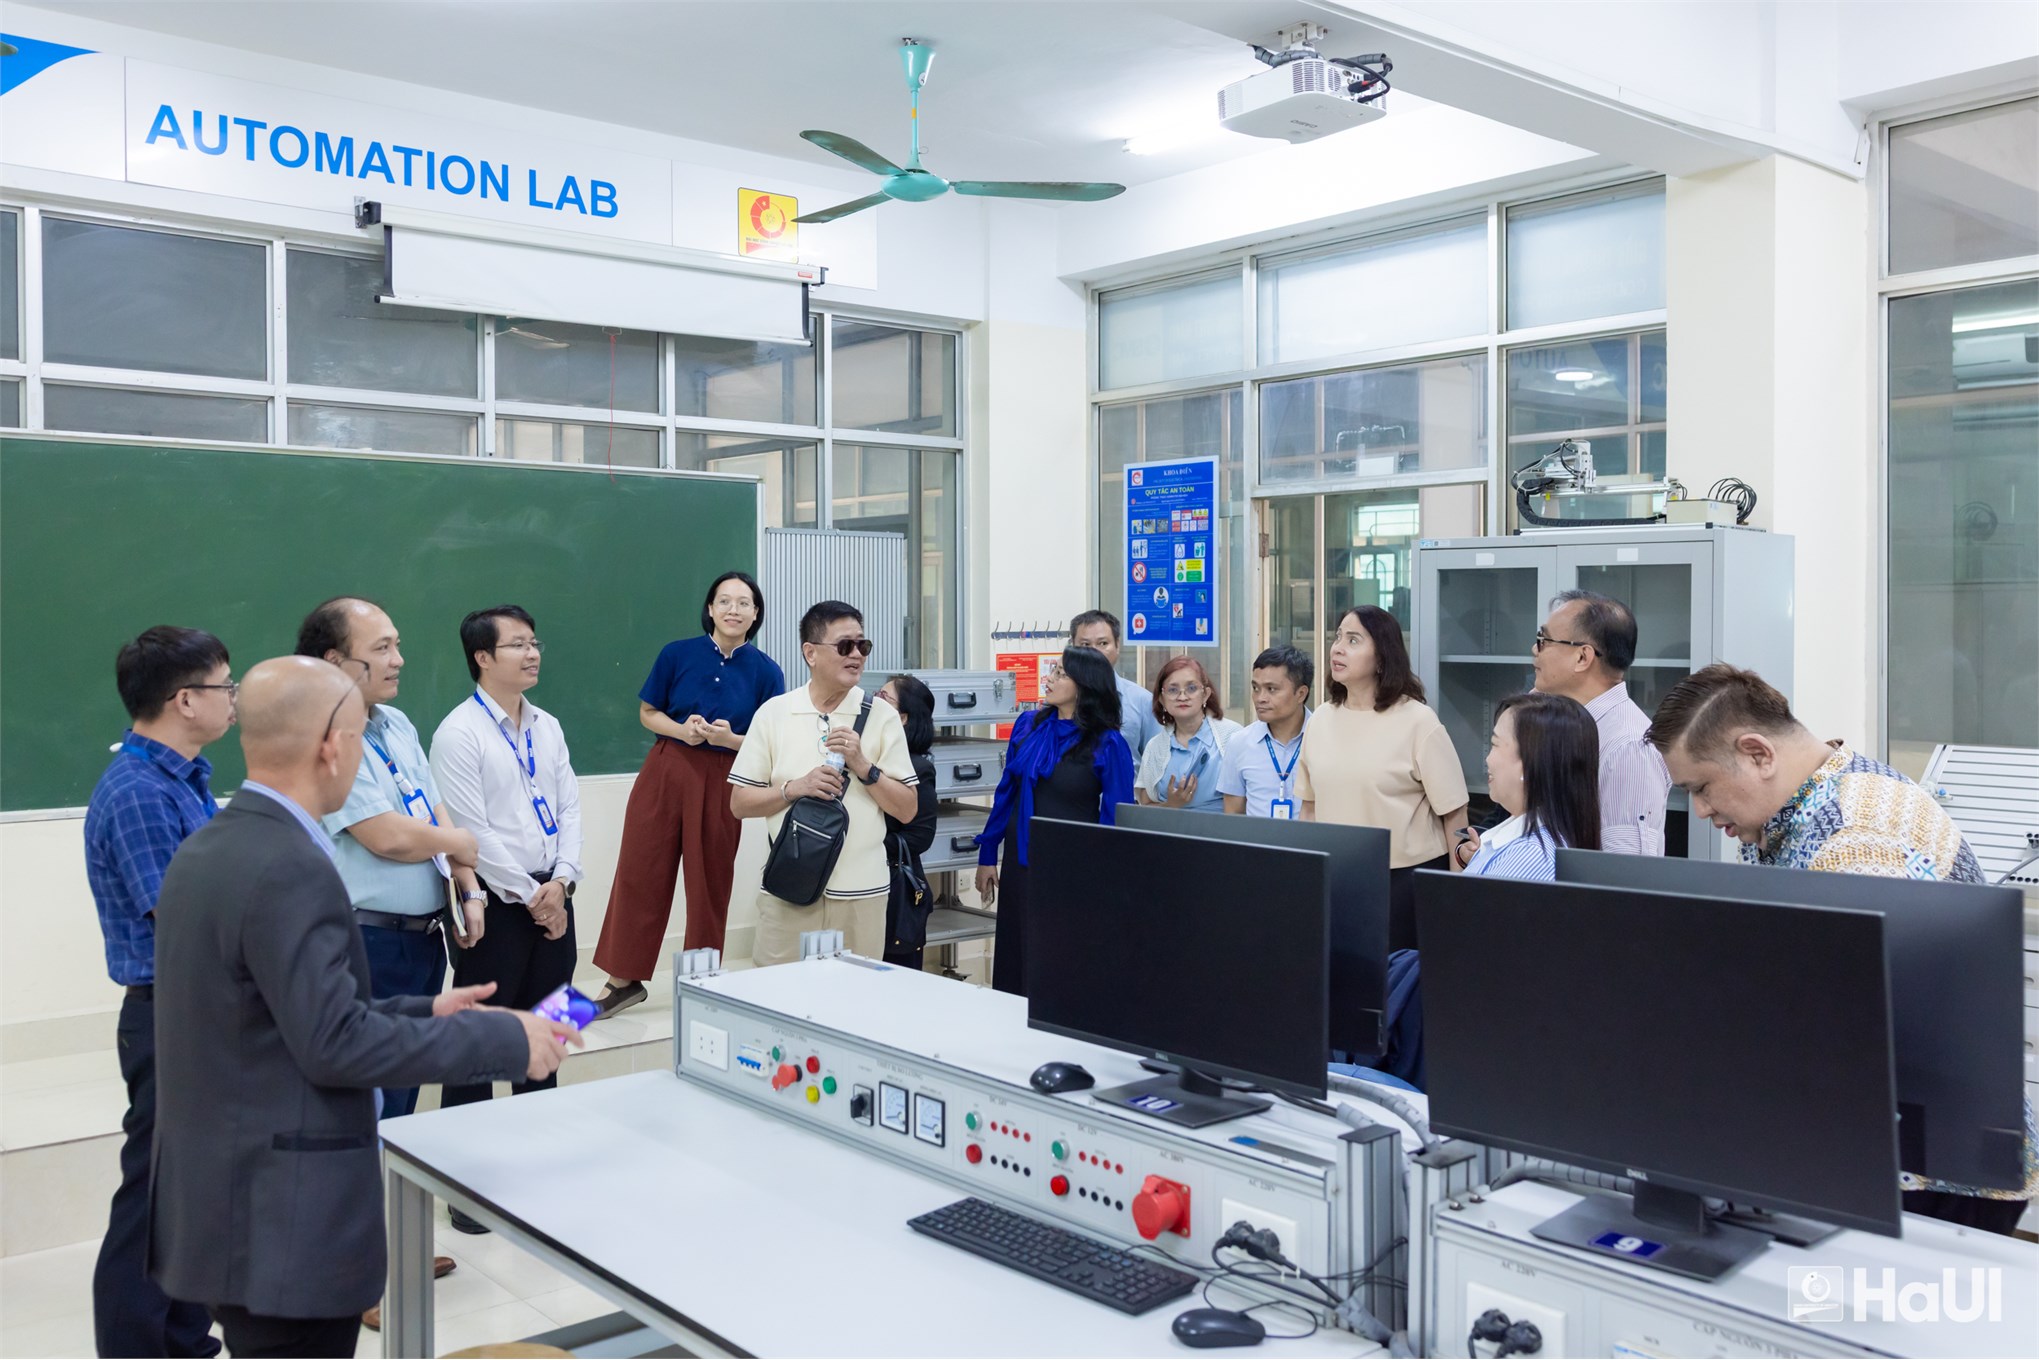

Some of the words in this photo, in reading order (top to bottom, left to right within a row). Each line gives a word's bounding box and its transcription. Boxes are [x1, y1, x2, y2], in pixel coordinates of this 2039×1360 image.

[145, 104, 509, 202] AUTOMATION
[529, 169, 618, 218] LAB
[1145, 489, 1157, 497] QUY
[1155, 1052, 1169, 1062] DELL
[1136, 1096, 1171, 1110] 10
[1626, 1168, 1648, 1181] DELL
[1613, 1236, 1644, 1252] 9
